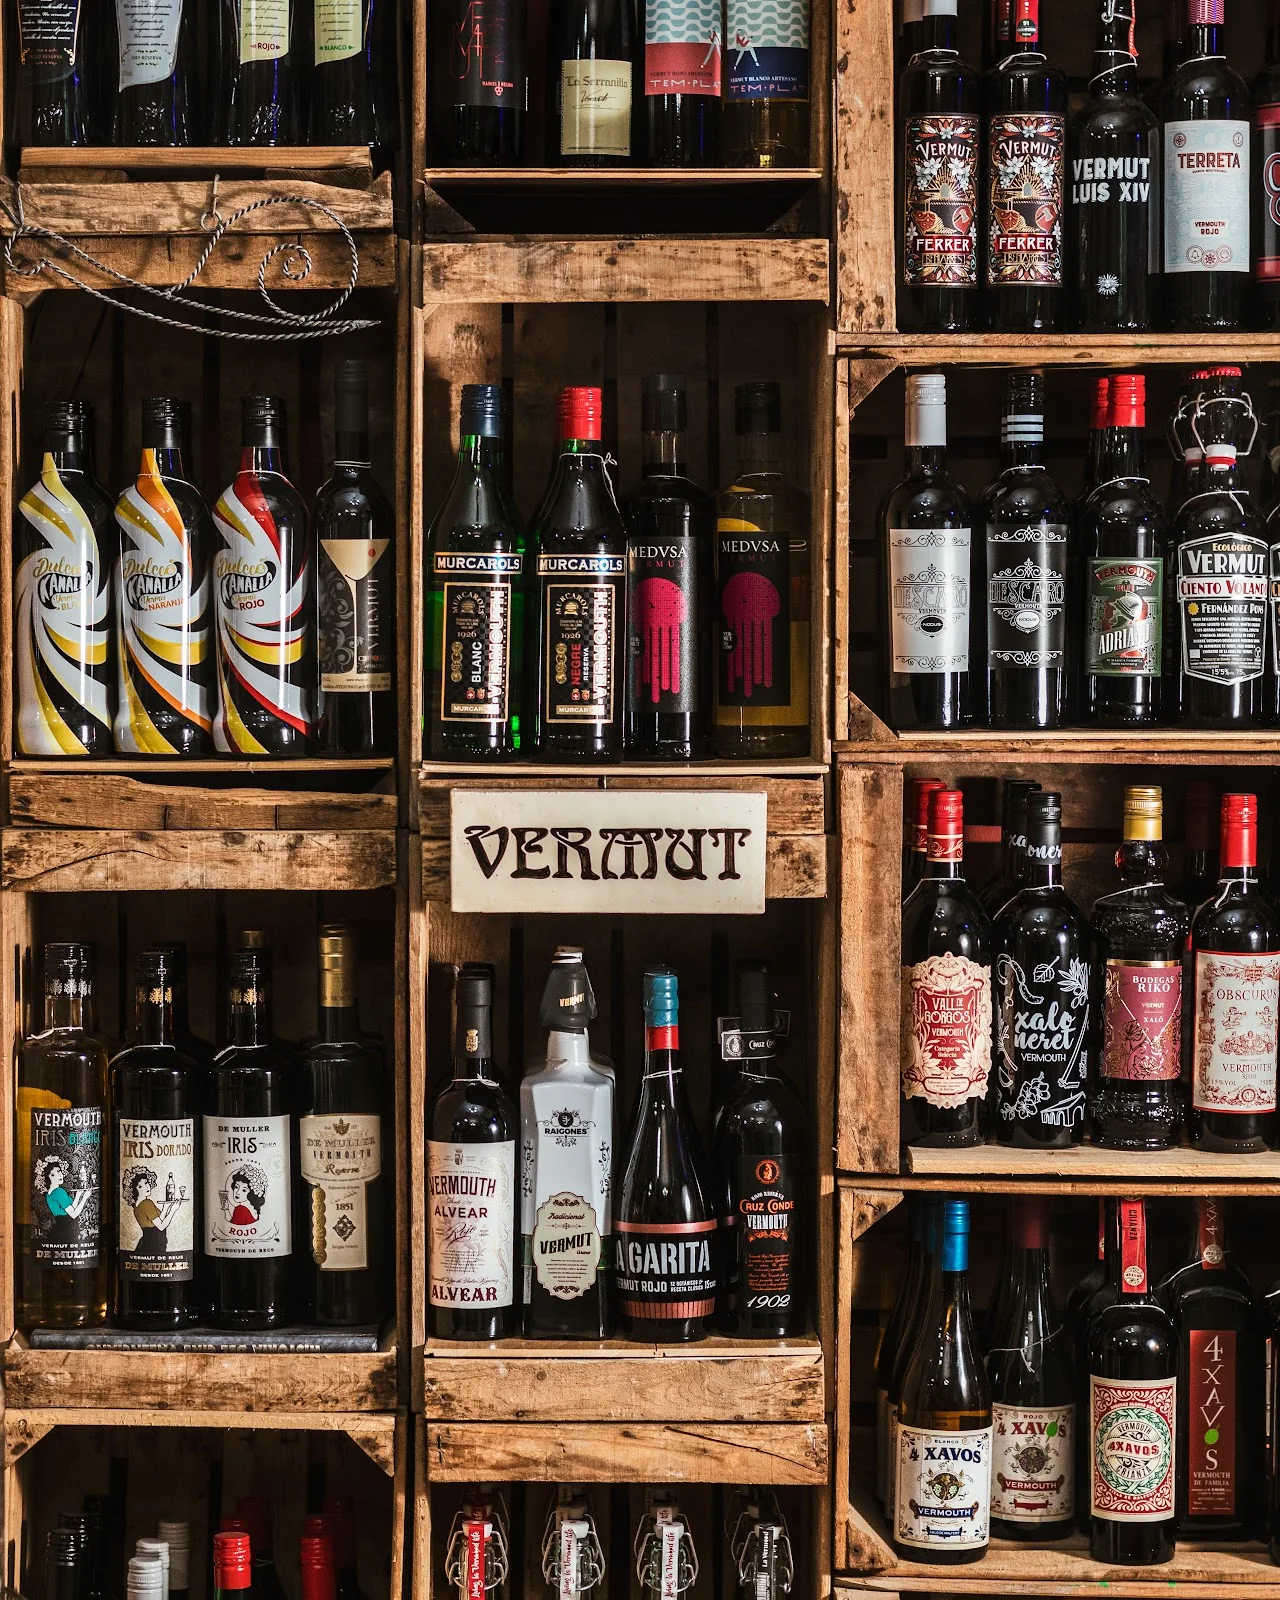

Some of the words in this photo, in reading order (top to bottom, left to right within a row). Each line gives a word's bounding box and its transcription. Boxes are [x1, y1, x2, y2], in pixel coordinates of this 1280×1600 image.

[257, 42, 276, 51] ROJO
[564, 76, 581, 87] La
[582, 76, 629, 88] Serranilla
[915, 141, 973, 160] VERMUT
[999, 139, 1057, 158] VERMUT
[1177, 152, 1241, 170] TERRETA
[1072, 157, 1151, 181] VERMUT
[1072, 182, 1111, 205] LUIS
[1118, 181, 1150, 202] XIV
[916, 238, 970, 252] FERRER
[999, 237, 1053, 251] FERRER
[630, 546, 689, 559] MEDVSA
[722, 540, 781, 553] MEDVSA
[437, 557, 520, 570] MURCAROLS
[539, 558, 623, 572] MURCAROLS
[1187, 550, 1266, 574] VERMUT
[1096, 564, 1156, 583] VERMOUTH
[128, 573, 181, 605] KANALLA
[222, 572, 273, 603] KANALLA
[990, 581, 1064, 605] DESCARO
[1181, 580, 1222, 596] CIENTO
[239, 599, 265, 611] ROJO
[452, 591, 485, 616] MURCAROLS
[556, 592, 589, 617] MURCAROLS
[1201, 603, 1248, 615] FERNÁNDEZ
[367, 579, 379, 651] VERMUT
[561, 632, 581, 640] 1926
[488, 590, 504, 699] VERMOUTH
[593, 591, 608, 699] VERMOUTH
[471, 641, 482, 683] BLANC
[571, 643, 581, 685] NEGRE
[464, 825, 753, 881] VERMUT
[1133, 975, 1174, 984] BODEGAS
[1217, 989, 1277, 1001] OBSCURUS
[933, 998, 957, 1011] VALL
[925, 1011, 970, 1024] GORGOS
[931, 1027, 963, 1037] VERMOUTH
[749, 1040, 766, 1050] CRUZ
[1014, 1029, 1076, 1050] neret
[1021, 1052, 1067, 1062] VERMOUTH
[1223, 1063, 1272, 1073] VERMOUTH
[34, 1112, 101, 1127] VERMOUTH
[123, 1124, 192, 1138] VERMOUTH
[35, 1130, 66, 1147] IRIS
[228, 1137, 257, 1153] IRIS
[307, 1138, 321, 1147] DE
[325, 1136, 376, 1147] MULLER
[123, 1140, 154, 1158] IRIS
[156, 1143, 192, 1156] DORADO
[313, 1149, 371, 1160] VERMOUTH
[430, 1176, 496, 1197] VERMOUTH
[336, 1203, 354, 1211] 1851
[434, 1205, 488, 1218] ALVEAR
[740, 1199, 765, 1214] CRUZ
[768, 1198, 794, 1214] CONDE
[548, 1212, 586, 1220] Tradicional
[747, 1214, 788, 1230] VERMOUTH
[1129, 1210, 1138, 1240] CRIANZA
[229, 1228, 257, 1237] ROJO
[540, 1232, 594, 1255] VERMUT
[36, 1250, 51, 1258] DE
[54, 1249, 98, 1258] MULLER
[616, 1240, 711, 1275] AGARITA
[125, 1261, 139, 1269] DE
[141, 1261, 189, 1270] MULLER
[432, 1285, 498, 1302] ALVEAR
[641, 1281, 667, 1293] ROJO
[747, 1295, 791, 1309] 1902
[997, 1422, 1006, 1436] 4
[1116, 1422, 1152, 1434] VERMOUTH
[909, 1447, 919, 1461] 4
[924, 1448, 981, 1464] XAVOS
[1115, 1465, 1152, 1480] CRIANZA
[1193, 1471, 1231, 1479] VERMOUTH
[1005, 1480, 1057, 1490] VERMOUTH
[918, 1507, 971, 1517] VERMOUTH
[470, 1530, 481, 1542] life
[564, 1528, 574, 1540] life
[665, 1531, 675, 1542] life
[762, 1560, 769, 1568] La
[470, 1580, 481, 1599] Living
[562, 1577, 575, 1597] Living
